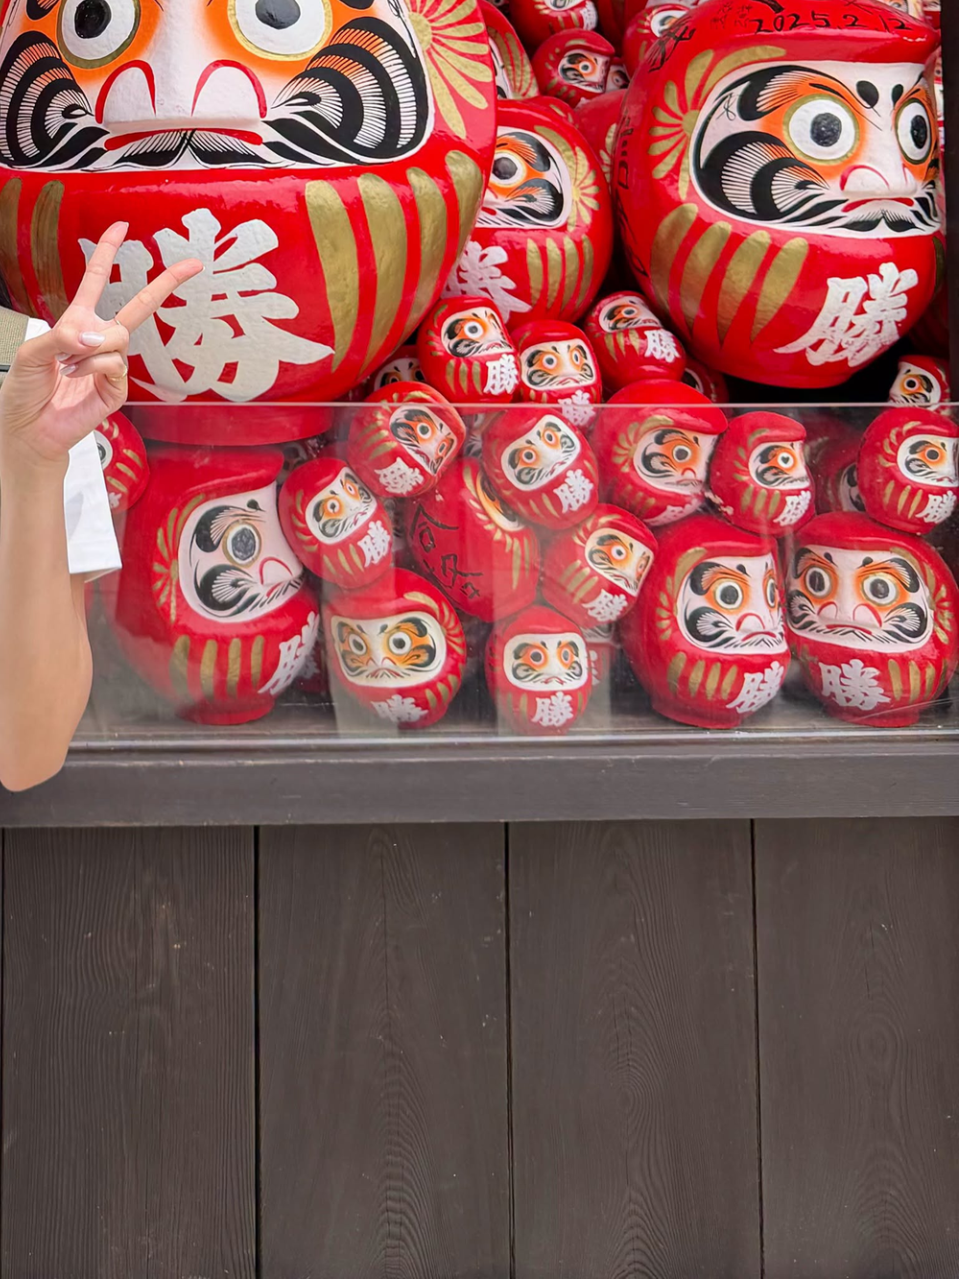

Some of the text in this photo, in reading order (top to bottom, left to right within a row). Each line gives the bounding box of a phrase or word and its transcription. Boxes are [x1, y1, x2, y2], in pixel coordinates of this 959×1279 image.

[77, 207, 336, 403] 勝
[773, 262, 918, 367] 勝
[644, 329, 680, 363] 勝
[484, 353, 519, 395] 勝
[558, 389, 596, 426] 勝
[374, 457, 425, 495] 勝
[553, 469, 594, 513] 勝
[773, 490, 812, 527] 勝
[915, 490, 957, 524] 勝
[357, 520, 390, 568] 勝
[726, 660, 785, 714] 勝
[818, 658, 891, 711] 勝
[532, 691, 574, 728] 勝
